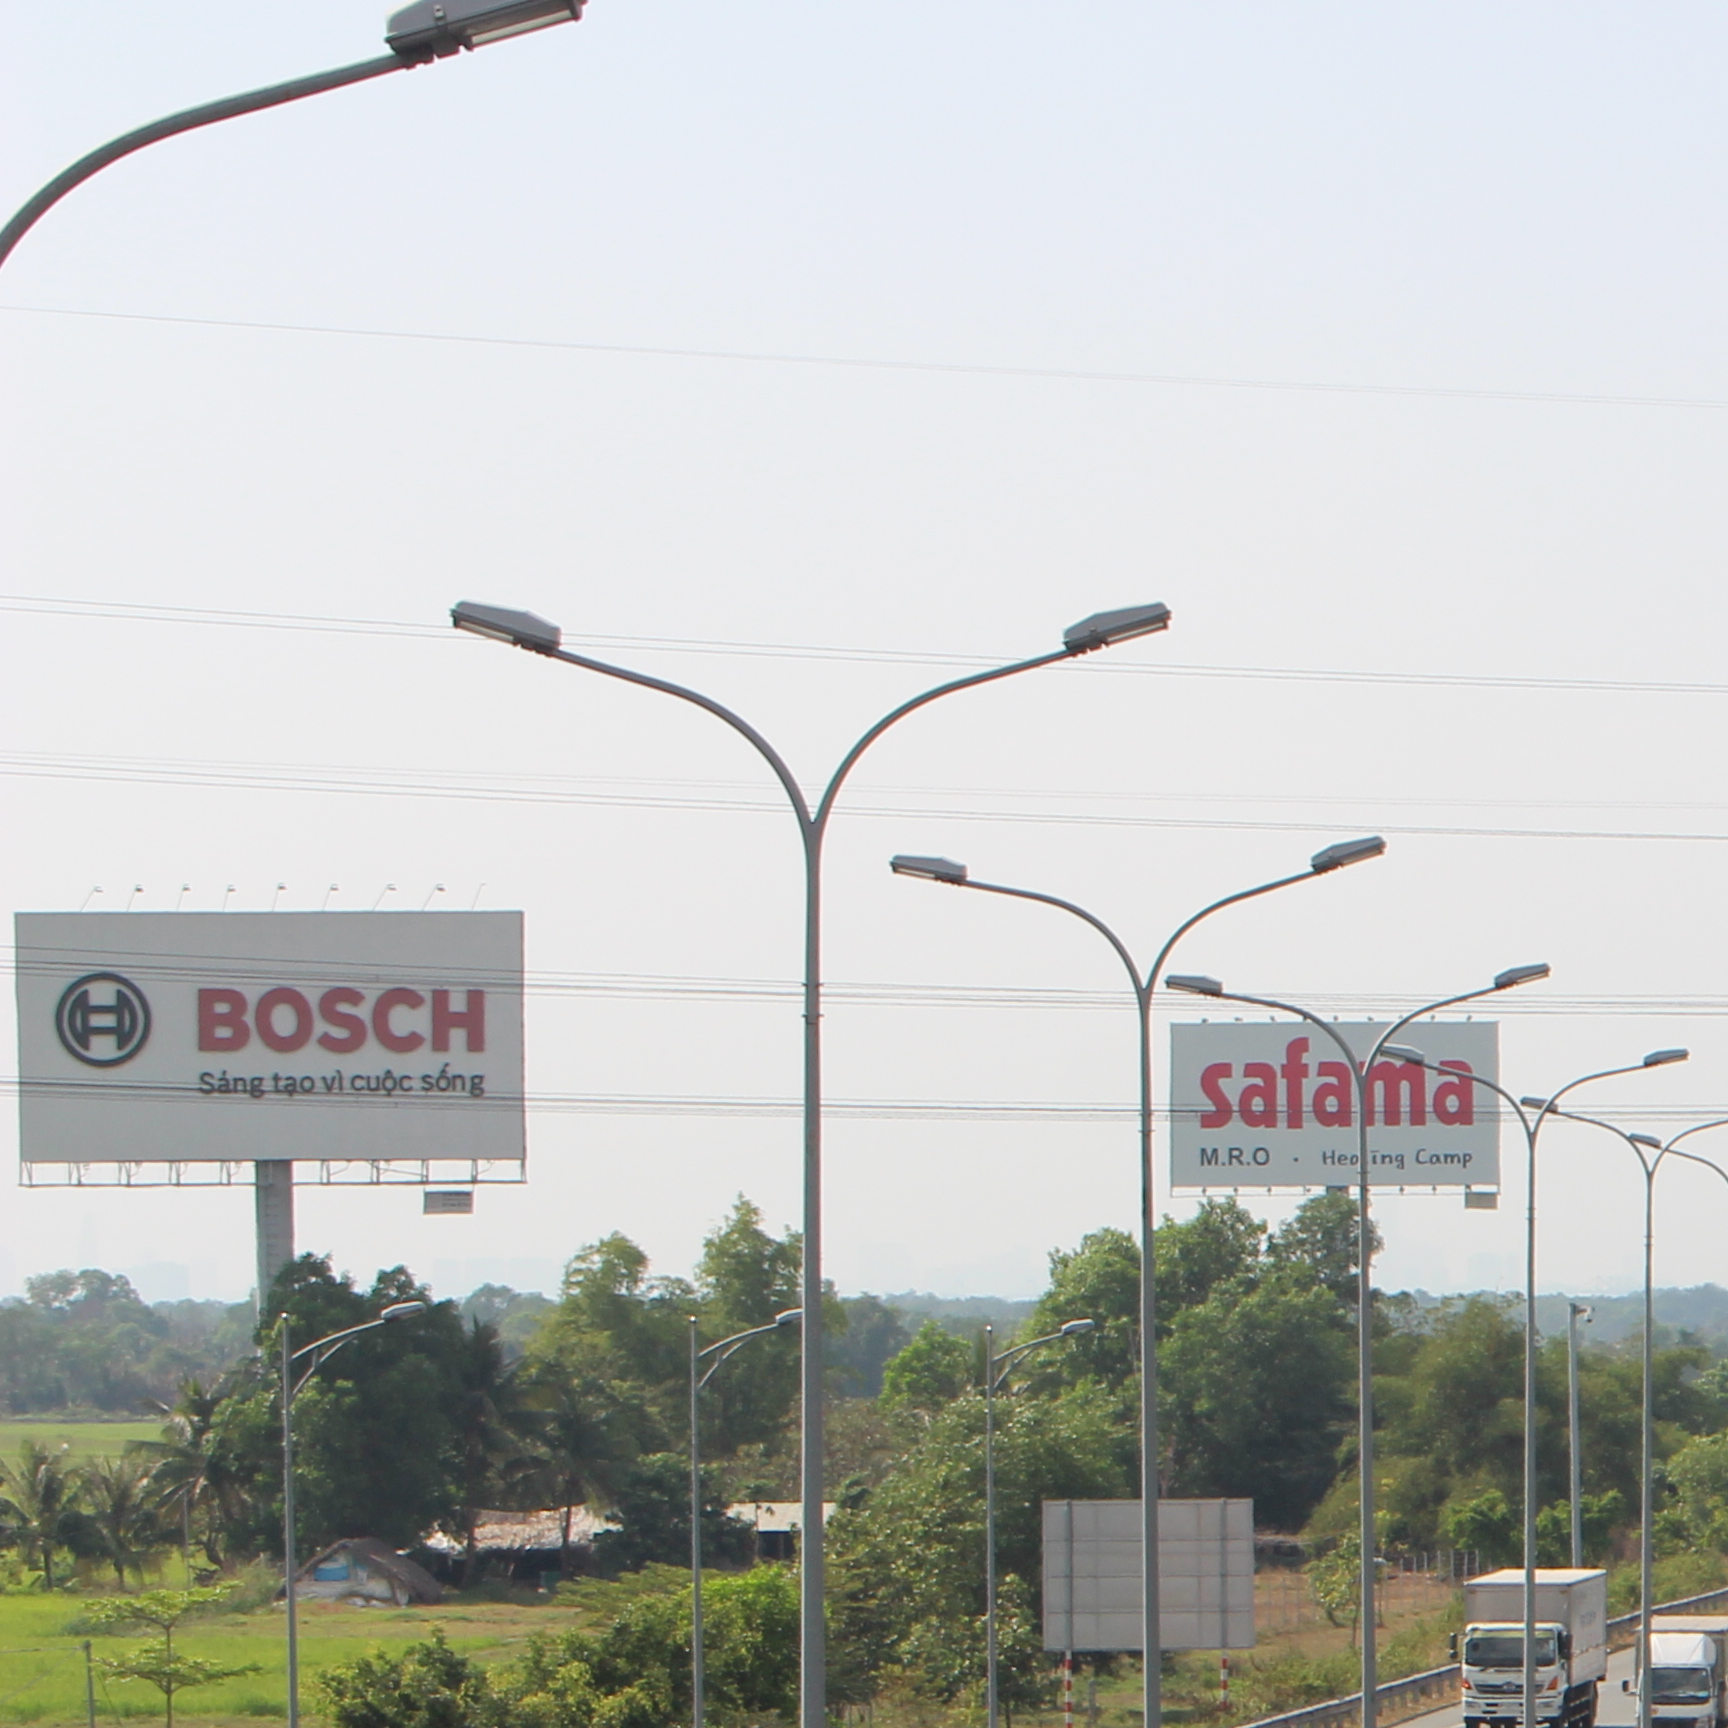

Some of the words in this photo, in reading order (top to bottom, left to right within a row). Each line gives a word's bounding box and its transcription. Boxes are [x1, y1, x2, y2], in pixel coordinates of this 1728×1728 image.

[197, 987, 486, 1053] BOSCH
[199, 1070, 265, 1099] Sáng
[271, 1072, 316, 1098] tạo
[321, 1069, 344, 1092] vì
[350, 1069, 414, 1096] cuộc
[420, 1062, 485, 1097] sống
[1200, 1036, 1475, 1130] safama
[1200, 1147, 1271, 1167] M.R.O
[1322, 1150, 1406, 1169] Heaing
[1415, 1146, 1473, 1169] Camp
